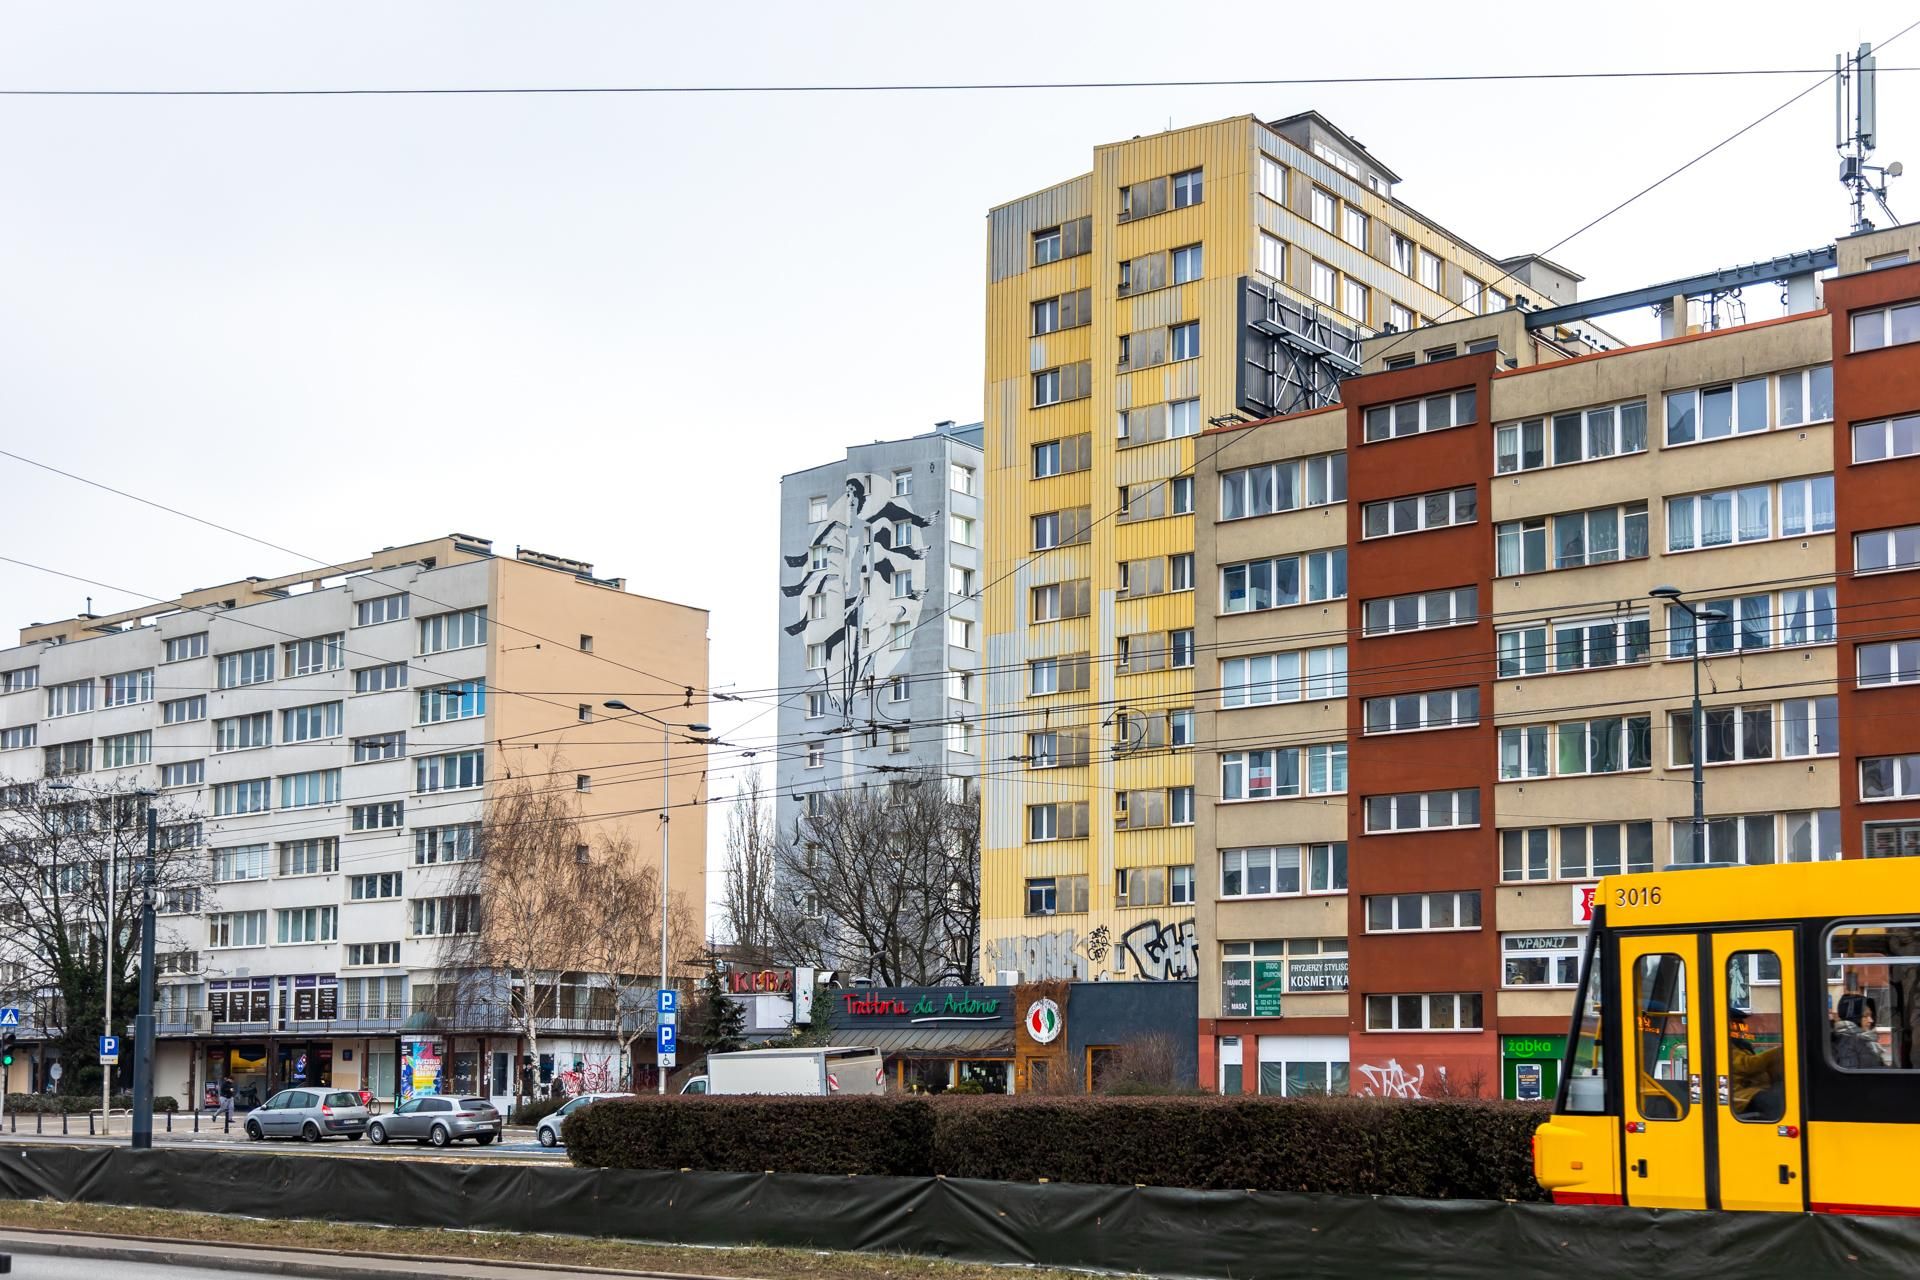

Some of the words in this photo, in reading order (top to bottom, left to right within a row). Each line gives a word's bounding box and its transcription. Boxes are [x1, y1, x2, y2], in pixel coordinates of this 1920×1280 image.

[1615, 886, 1662, 907] 3016
[1517, 937, 1567, 949] WPADNIJ
[1290, 963, 1323, 972] FRYZJERZY
[662, 993, 672, 1010] P
[842, 992, 909, 1015] Trattoria
[913, 994, 936, 1014] da
[943, 990, 1000, 1014] Antonio
[1231, 1002, 1248, 1010] MASAŻ
[662, 1027, 672, 1045] P
[104, 1038, 115, 1054] P
[1508, 1040, 1552, 1052] żabka
